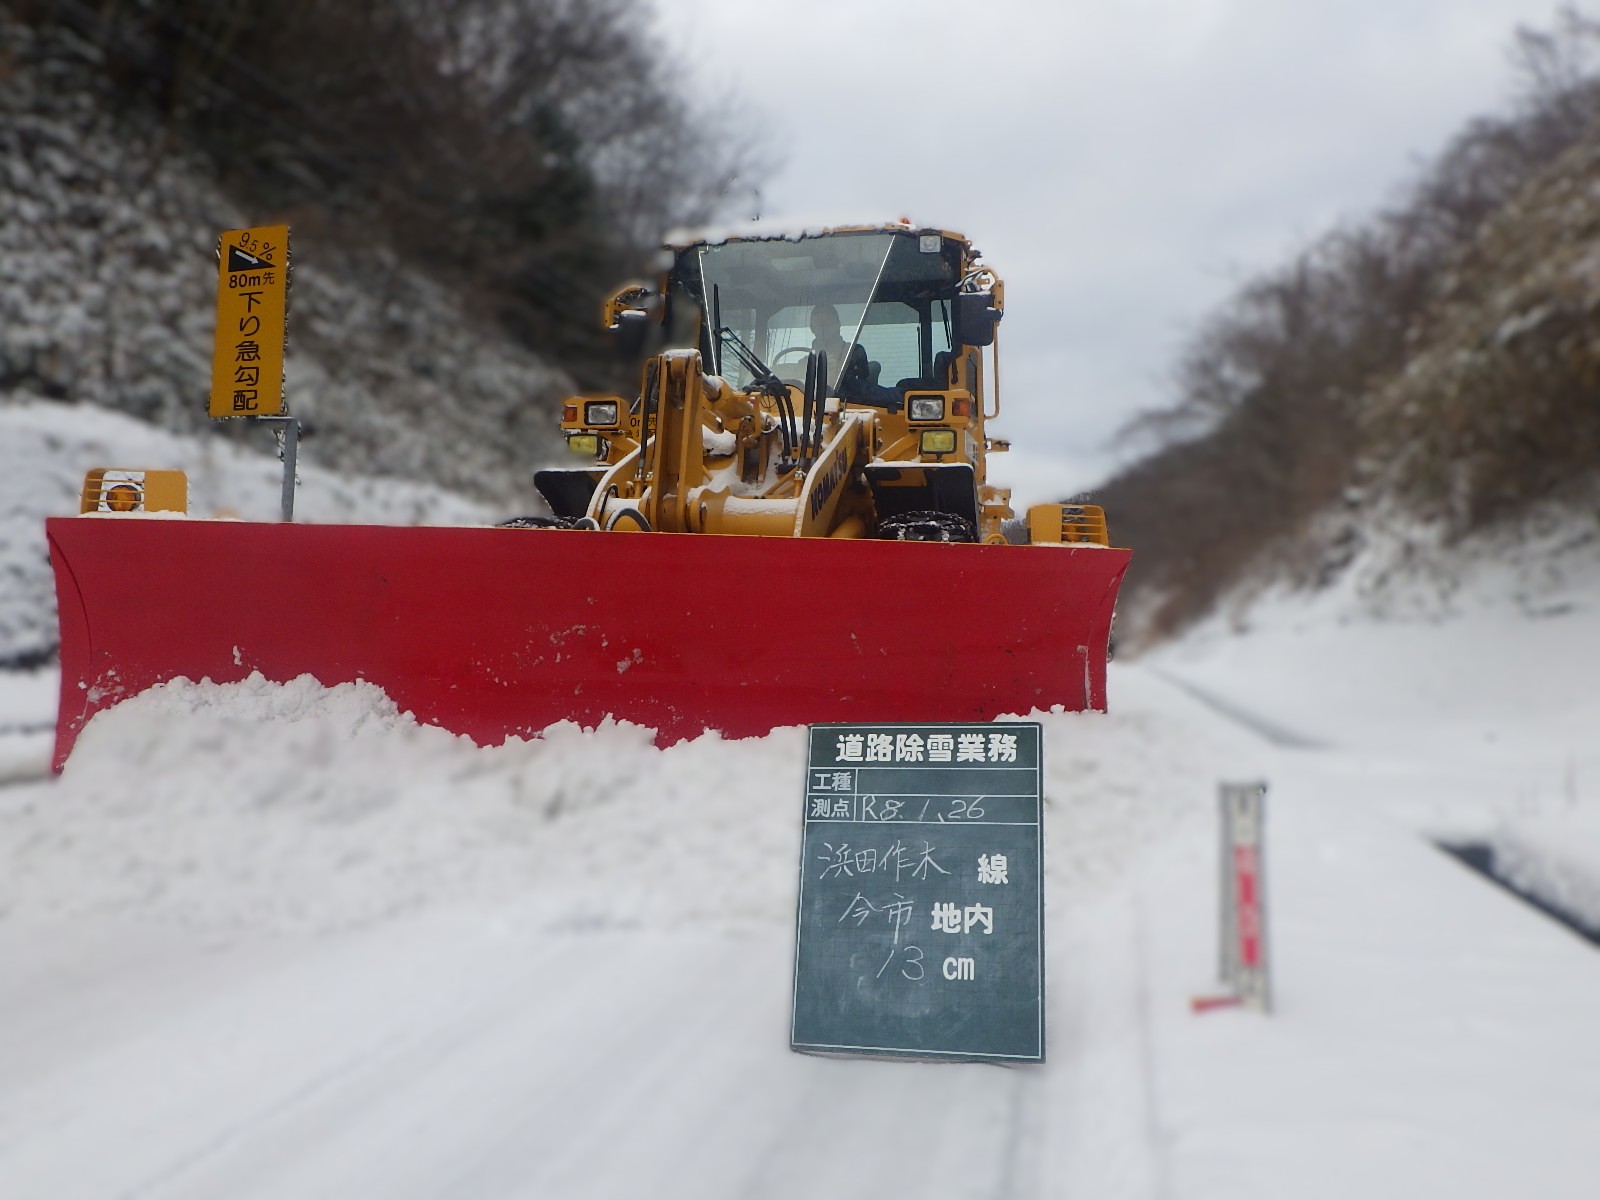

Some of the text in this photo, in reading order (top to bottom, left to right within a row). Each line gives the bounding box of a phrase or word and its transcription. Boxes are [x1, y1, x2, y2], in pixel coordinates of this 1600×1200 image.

[239, 232, 277, 261] 9.5%
[228, 271, 275, 289] 80m先
[232, 291, 264, 411] 下り急勾配
[810, 446, 848, 521] KOMATSU
[835, 733, 1018, 763] 道路除雪業務
[812, 772, 852, 791] 工種
[811, 798, 850, 818] 測点
[817, 839, 1009, 884] 浜田作木 線
[838, 892, 993, 944] 今市 地内
[876, 946, 975, 980] 13 cm
